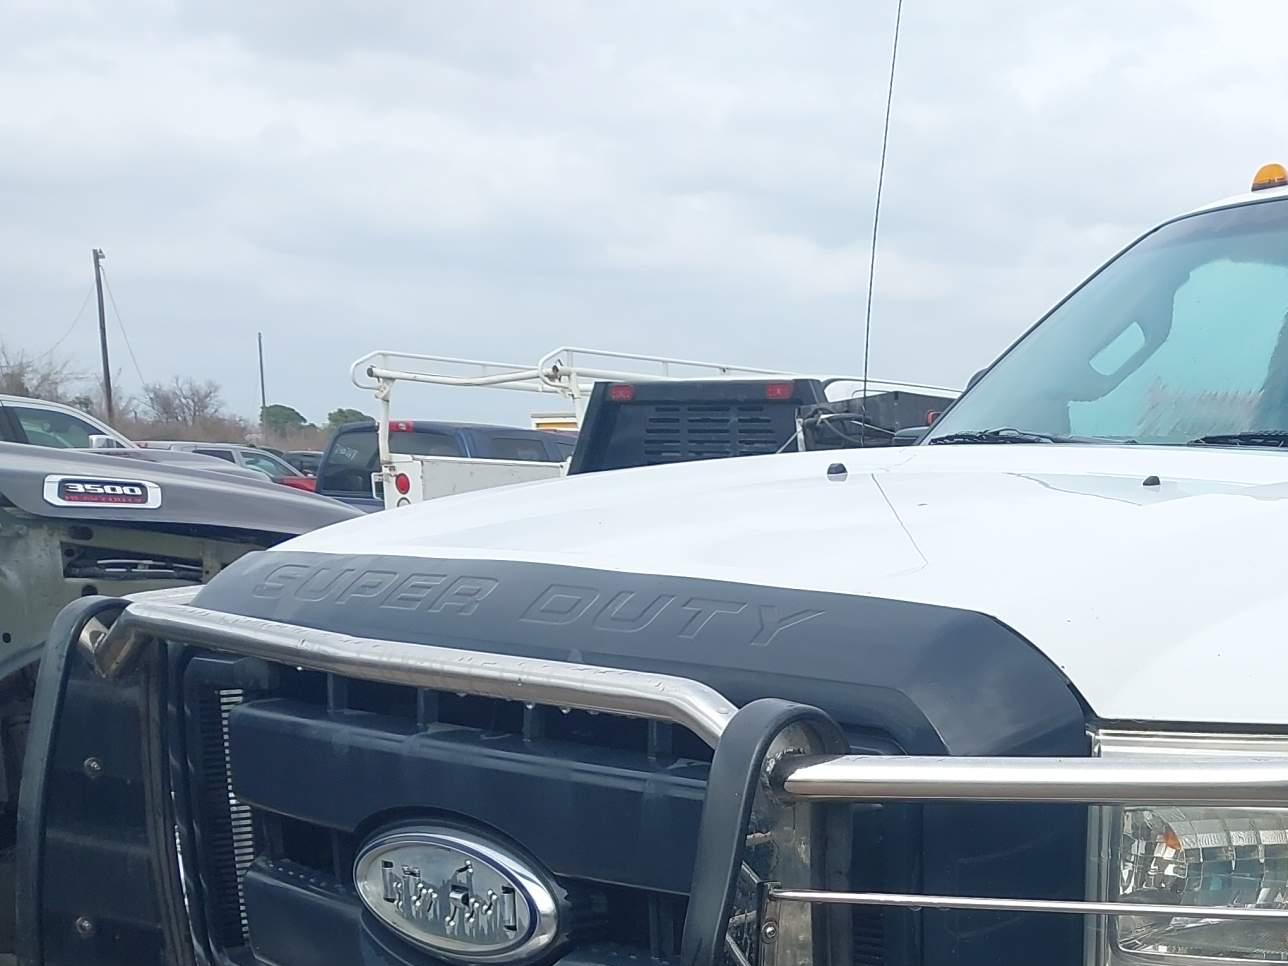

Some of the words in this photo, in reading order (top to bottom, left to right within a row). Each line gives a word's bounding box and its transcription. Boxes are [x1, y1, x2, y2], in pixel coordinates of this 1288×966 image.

[64, 483, 142, 496] 3500
[252, 563, 500, 618] SUPER
[518, 583, 826, 647] DUTY
